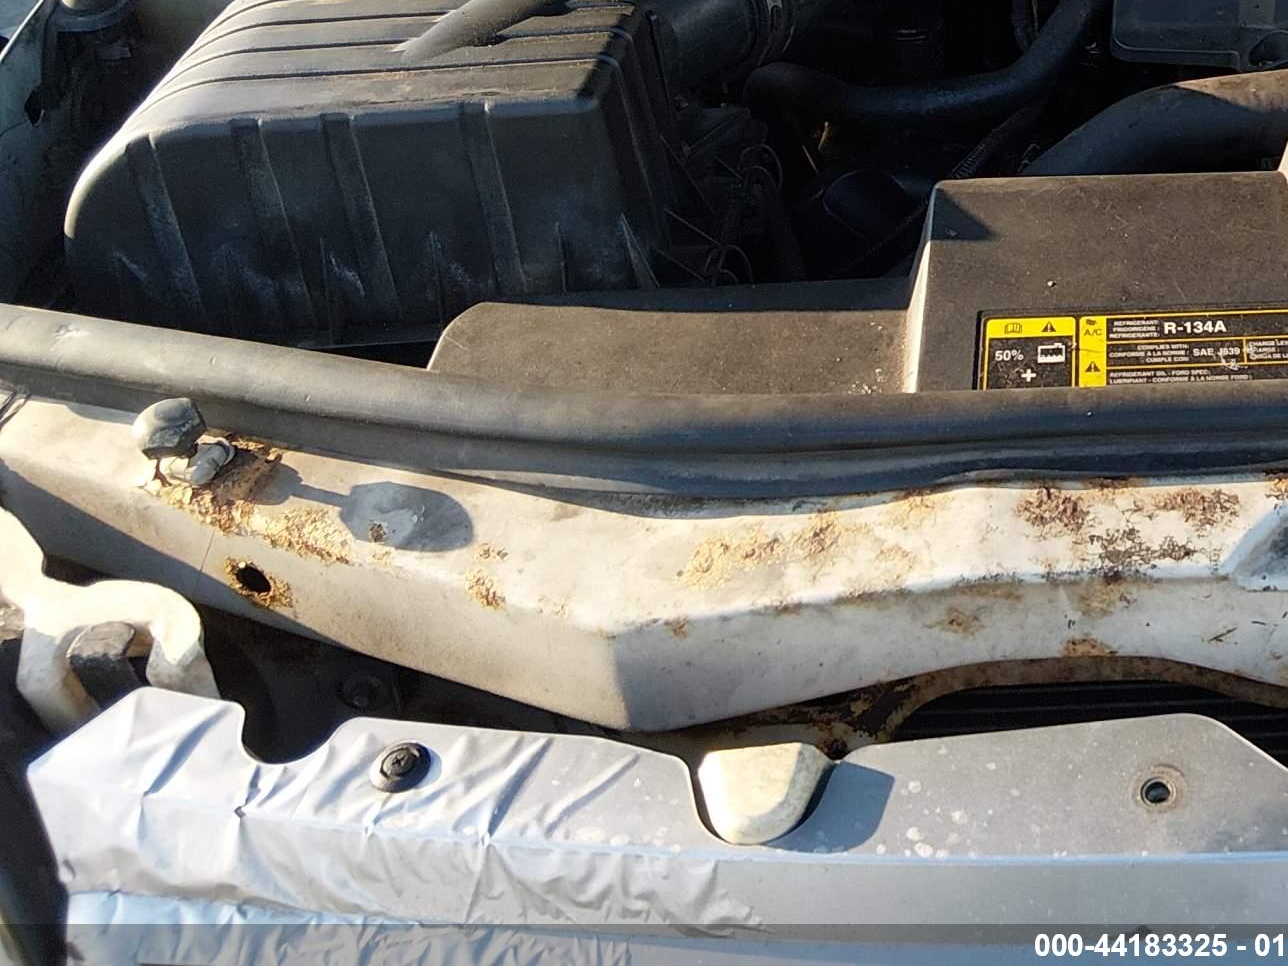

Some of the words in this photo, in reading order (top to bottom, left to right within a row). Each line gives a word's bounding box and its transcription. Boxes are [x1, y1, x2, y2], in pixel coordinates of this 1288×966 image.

[1163, 320, 1227, 334] R-134A
[1084, 328, 1103, 337] A/C
[994, 349, 1025, 361] 50%
[1193, 347, 1214, 356] SAE
